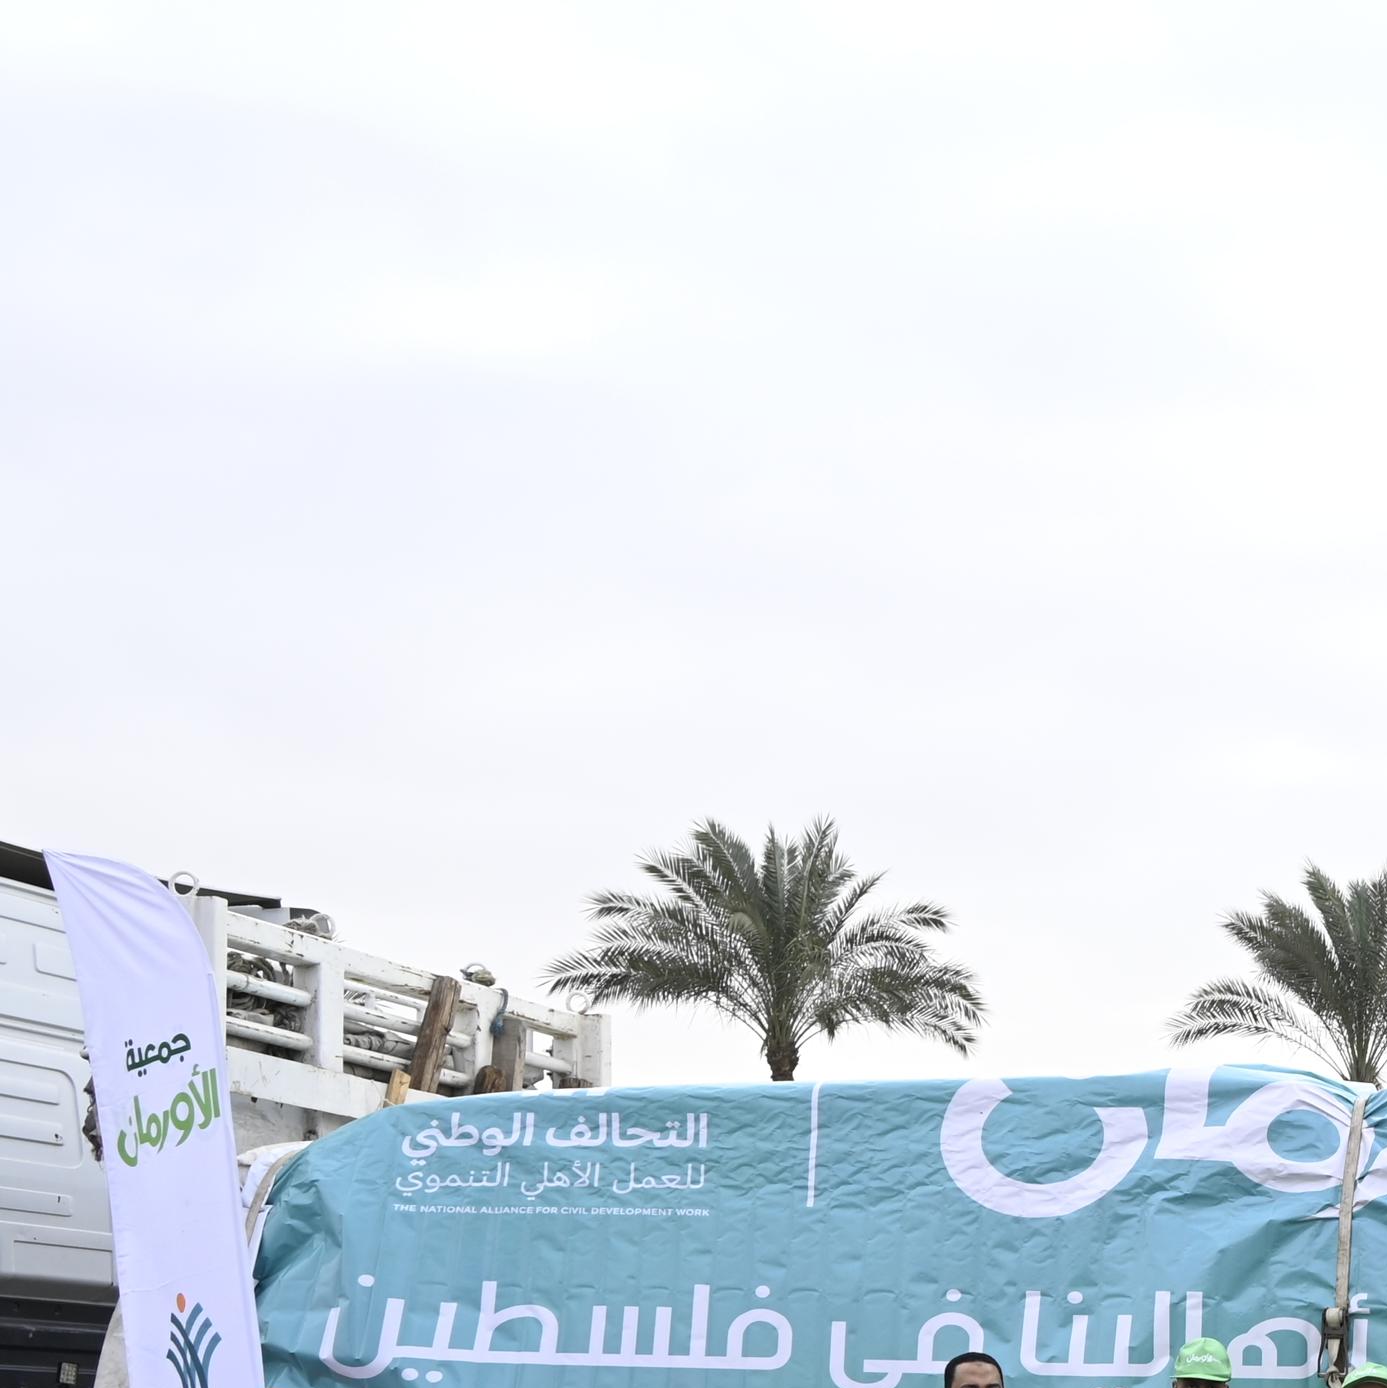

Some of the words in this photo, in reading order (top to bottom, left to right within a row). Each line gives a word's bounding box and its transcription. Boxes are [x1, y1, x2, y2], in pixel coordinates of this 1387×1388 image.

[124, 1033, 191, 1077] جمعية
[117, 1064, 220, 1167] الأورمان
[545, 1112, 708, 1148] التحالف
[401, 1112, 535, 1166] الوطني
[395, 1162, 510, 1196] التنموي
[521, 1160, 600, 1200] الأهلي
[612, 1162, 705, 1194] للعمل
[393, 1203, 416, 1213] THE
[420, 1205, 477, 1214] NATIONAL
[479, 1206, 533, 1214] ALLIANCE
[536, 1206, 557, 1214] FOR
[560, 1206, 588, 1215] CIVIL
[591, 1207, 673, 1216] DEVELOPMENT
[675, 1208, 710, 1217] WORK
[319, 1274, 792, 1384] فلسطين
